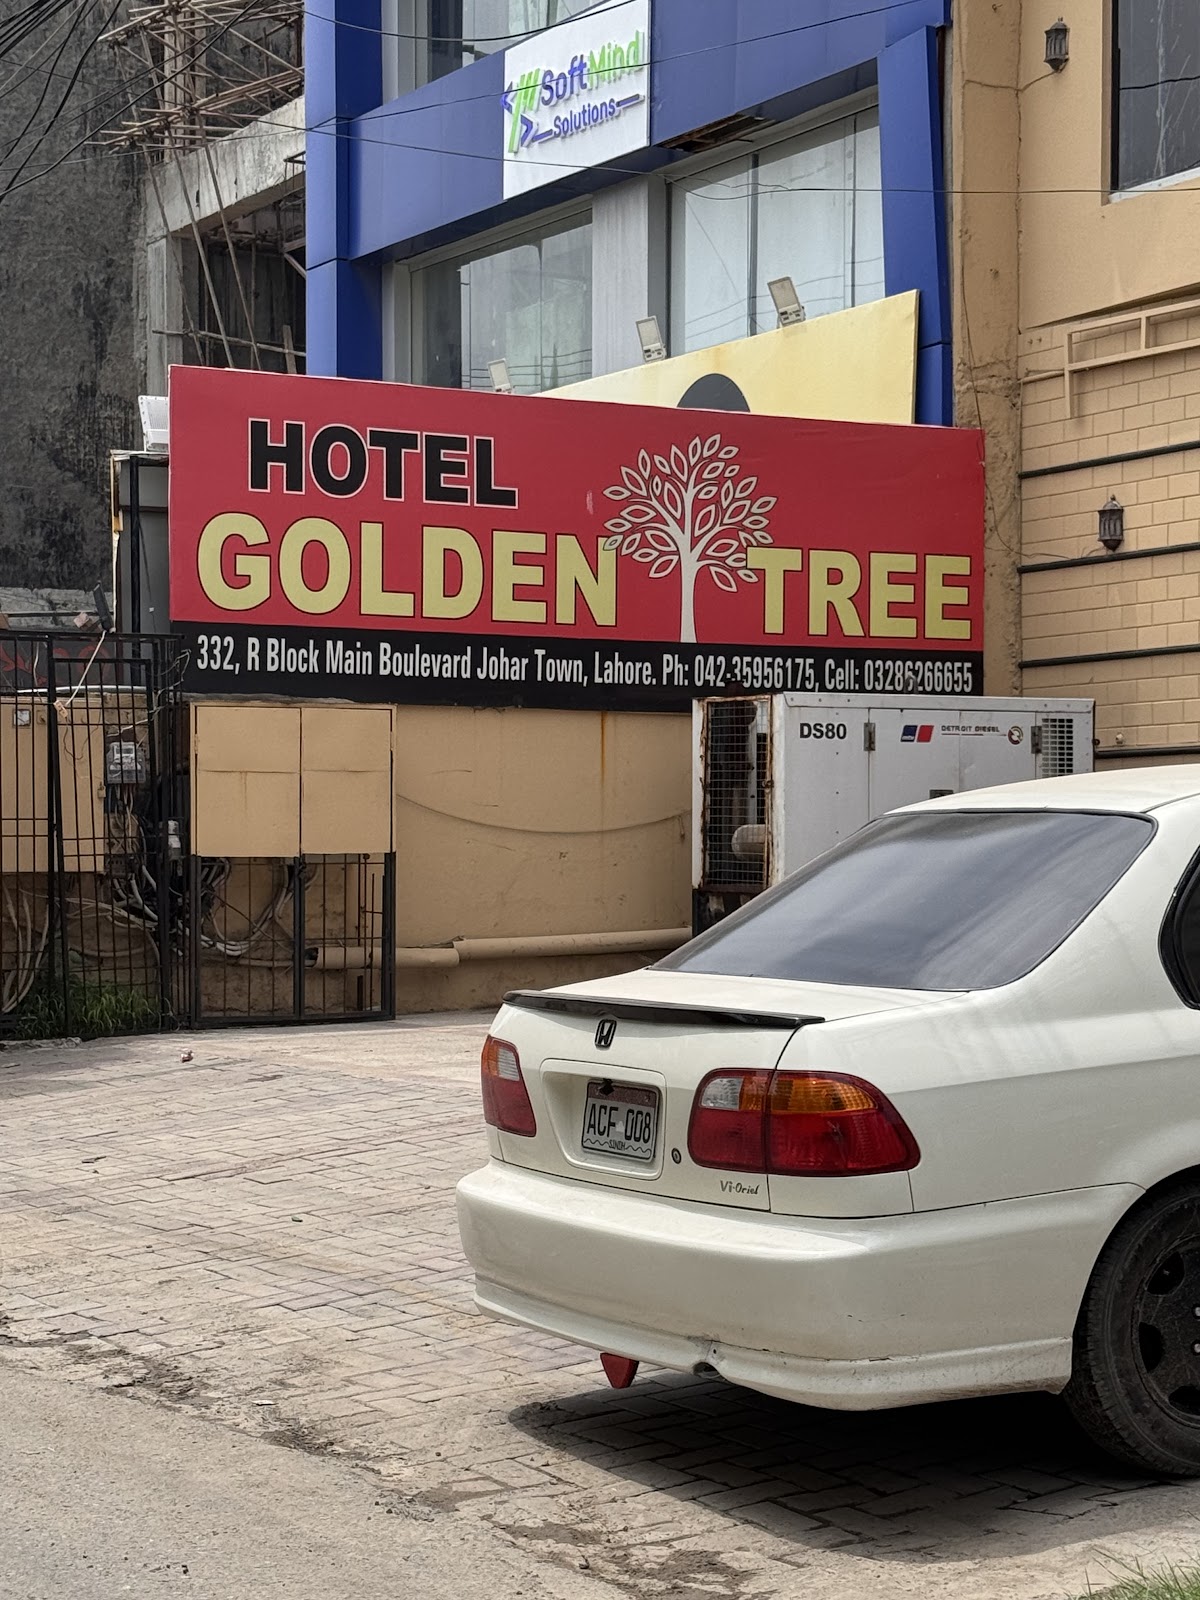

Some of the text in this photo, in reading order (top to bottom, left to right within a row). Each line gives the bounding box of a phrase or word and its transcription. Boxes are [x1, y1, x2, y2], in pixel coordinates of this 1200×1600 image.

[541, 30, 642, 106] SoftMind
[553, 98, 617, 137] Solutions
[248, 416, 519, 509] HOTEL
[197, 511, 971, 640] GOLDEN TREE
[197, 634, 240, 675] 332,
[247, 637, 260, 671] R
[266, 637, 319, 673] Block
[326, 639, 372, 675] Main
[379, 642, 471, 679] Boulevard
[476, 646, 529, 681] Johar
[534, 648, 588, 687] Town,
[594, 651, 657, 685] Lahore.
[662, 653, 689, 686] Ph:
[824, 658, 860, 690] Cell:
[799, 722, 847, 740] DS80
[974, 725, 1000, 733] DIESEL
[586, 1103, 651, 1144] ACF 008
